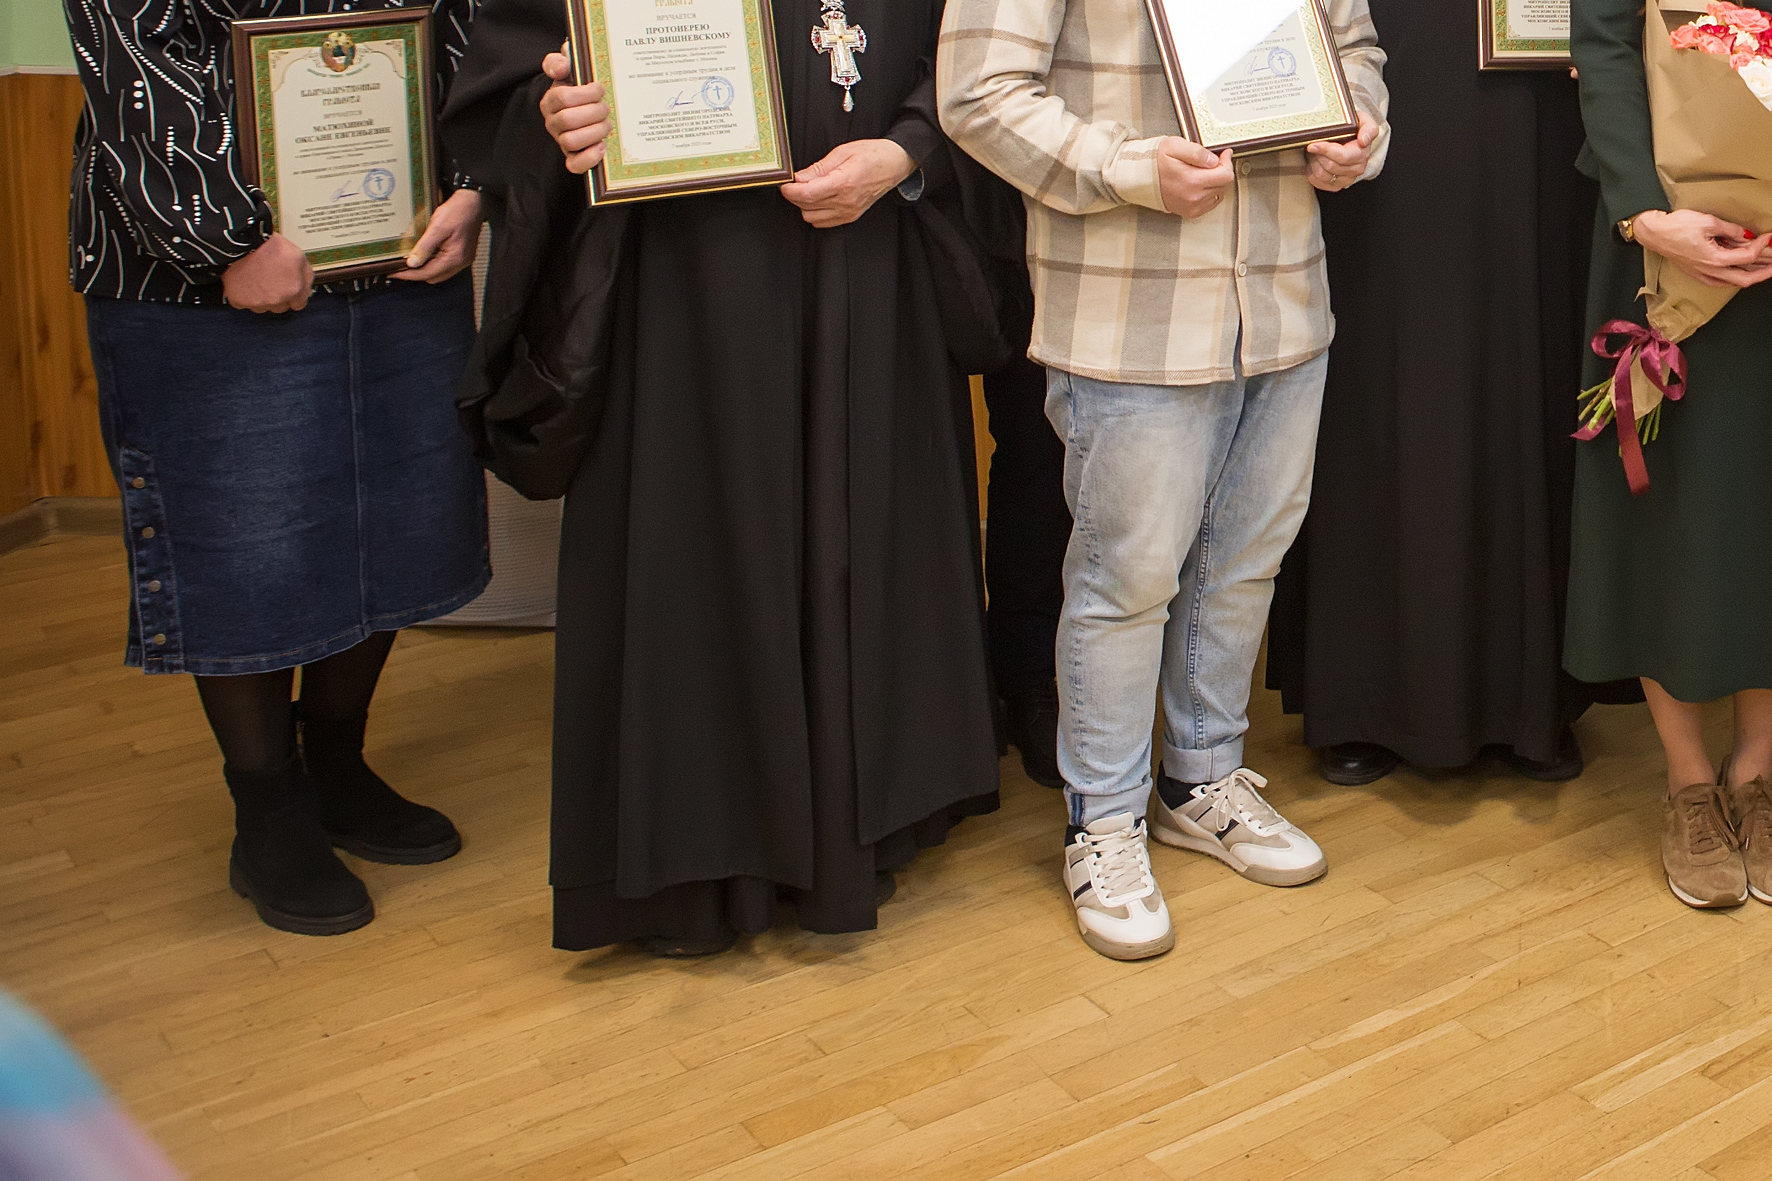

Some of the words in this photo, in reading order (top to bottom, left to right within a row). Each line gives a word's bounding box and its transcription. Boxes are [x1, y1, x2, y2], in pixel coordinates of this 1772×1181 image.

[646, 23, 710, 34] ПРОТОИЕРЕЮ
[625, 37, 657, 46] ПАВЛУ
[659, 31, 731, 44] ВИШНЕВСКОМУ
